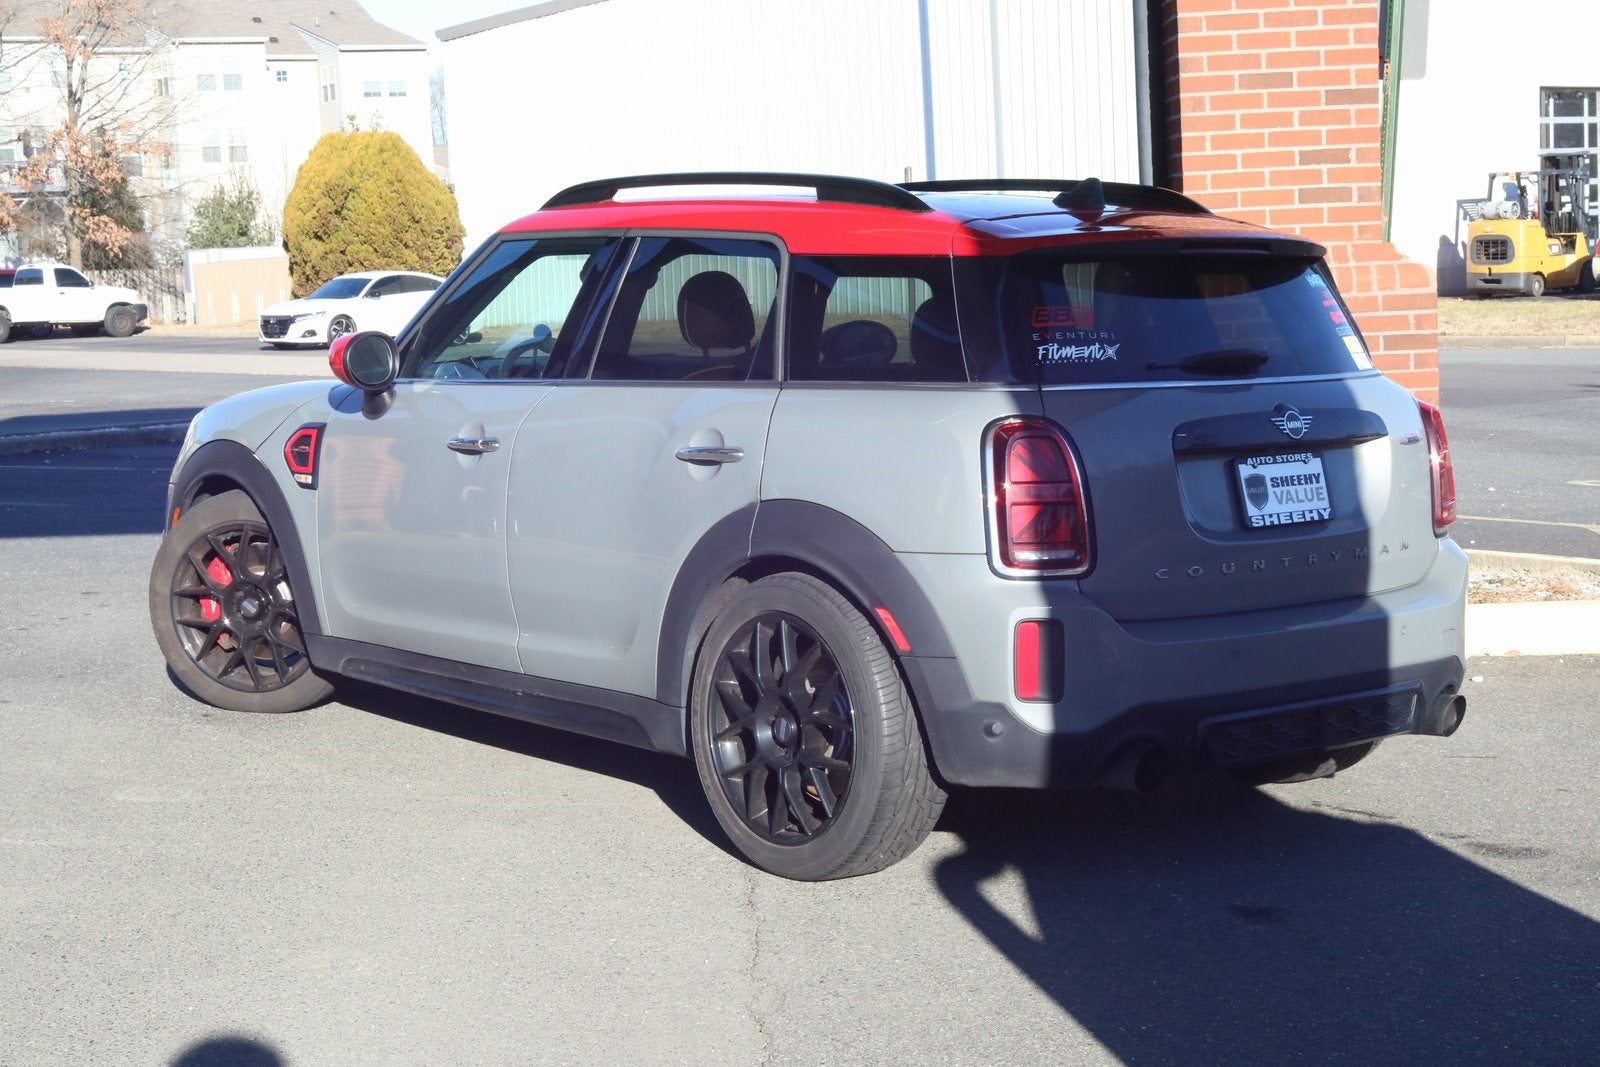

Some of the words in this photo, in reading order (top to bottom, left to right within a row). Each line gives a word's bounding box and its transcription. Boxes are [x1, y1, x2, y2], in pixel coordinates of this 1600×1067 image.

[1032, 332, 1115, 341] EVENTURI
[1287, 420, 1303, 429] MINI
[1246, 456, 1273, 466] AUTO
[1276, 453, 1313, 462] STORES
[1269, 473, 1321, 488] SHEEHY
[1273, 486, 1326, 505] VALUE
[1251, 508, 1331, 527] SHEEHY
[1155, 540, 1409, 579] COUNTRYMAN
